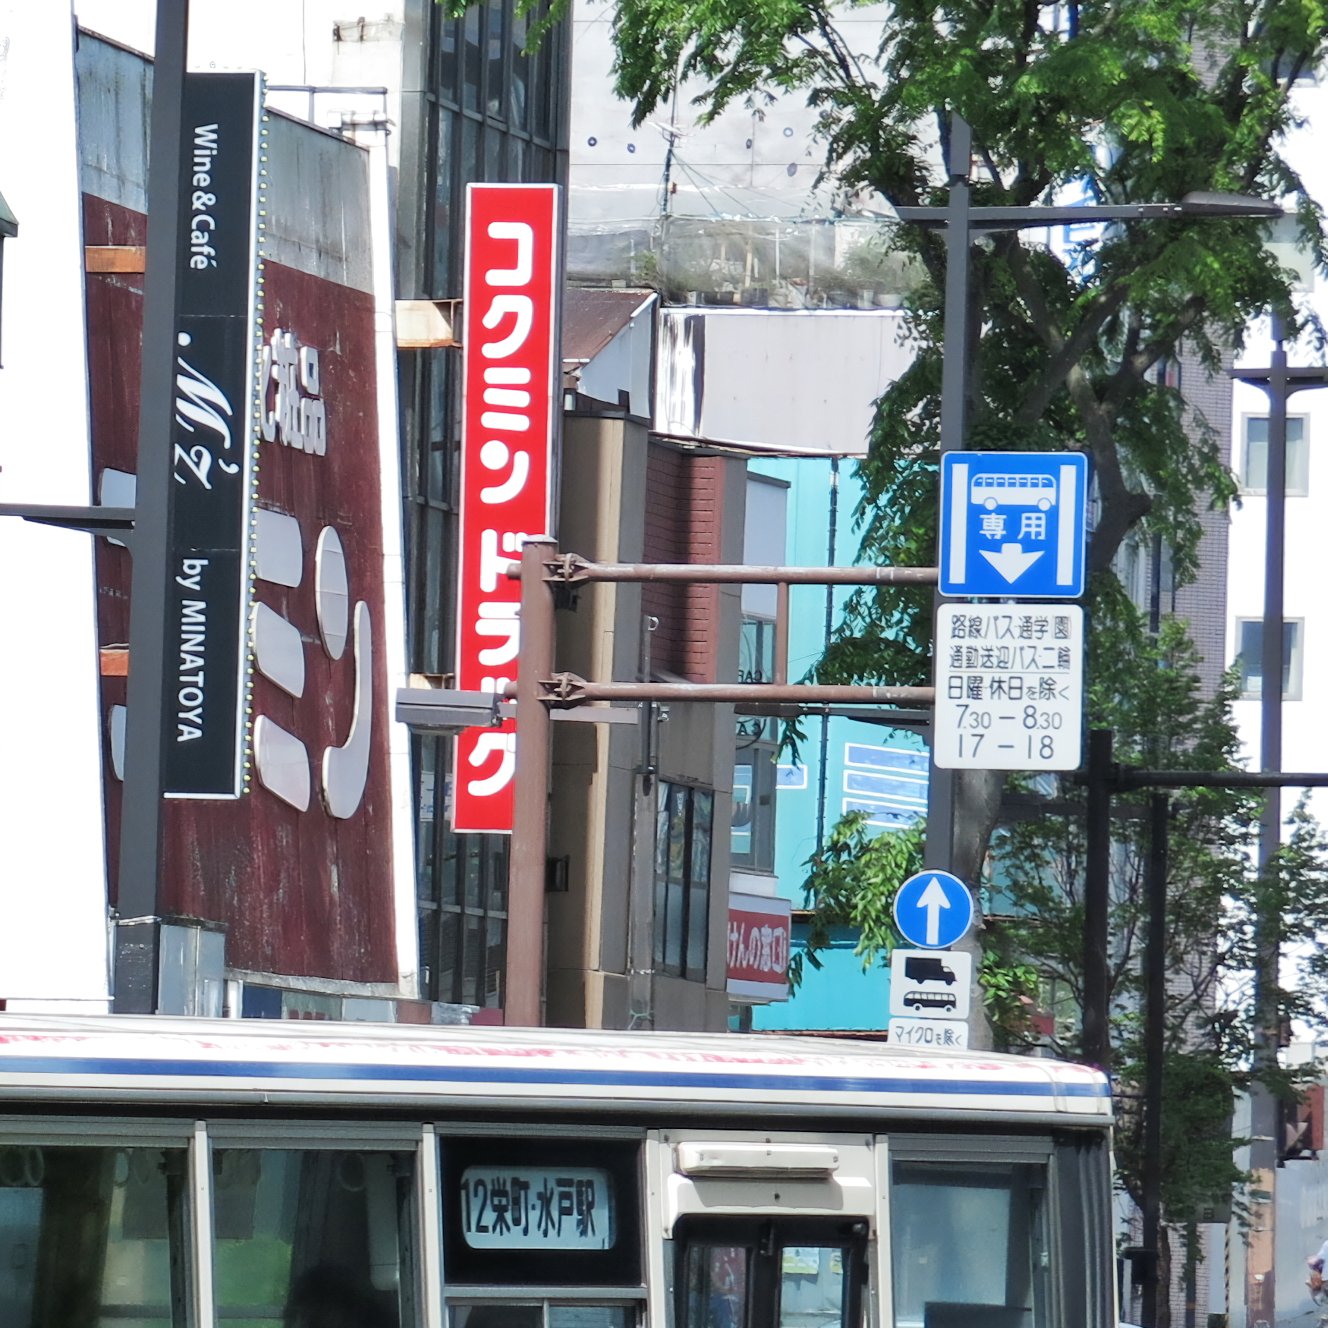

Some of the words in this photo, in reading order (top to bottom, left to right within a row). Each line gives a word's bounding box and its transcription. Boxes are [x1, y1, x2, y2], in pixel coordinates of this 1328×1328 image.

[190, 123, 219, 270] Wine&Café
[979, 512, 1046, 540] 専用
[175, 557, 209, 592] by
[176, 599, 207, 743] MINATOYA
